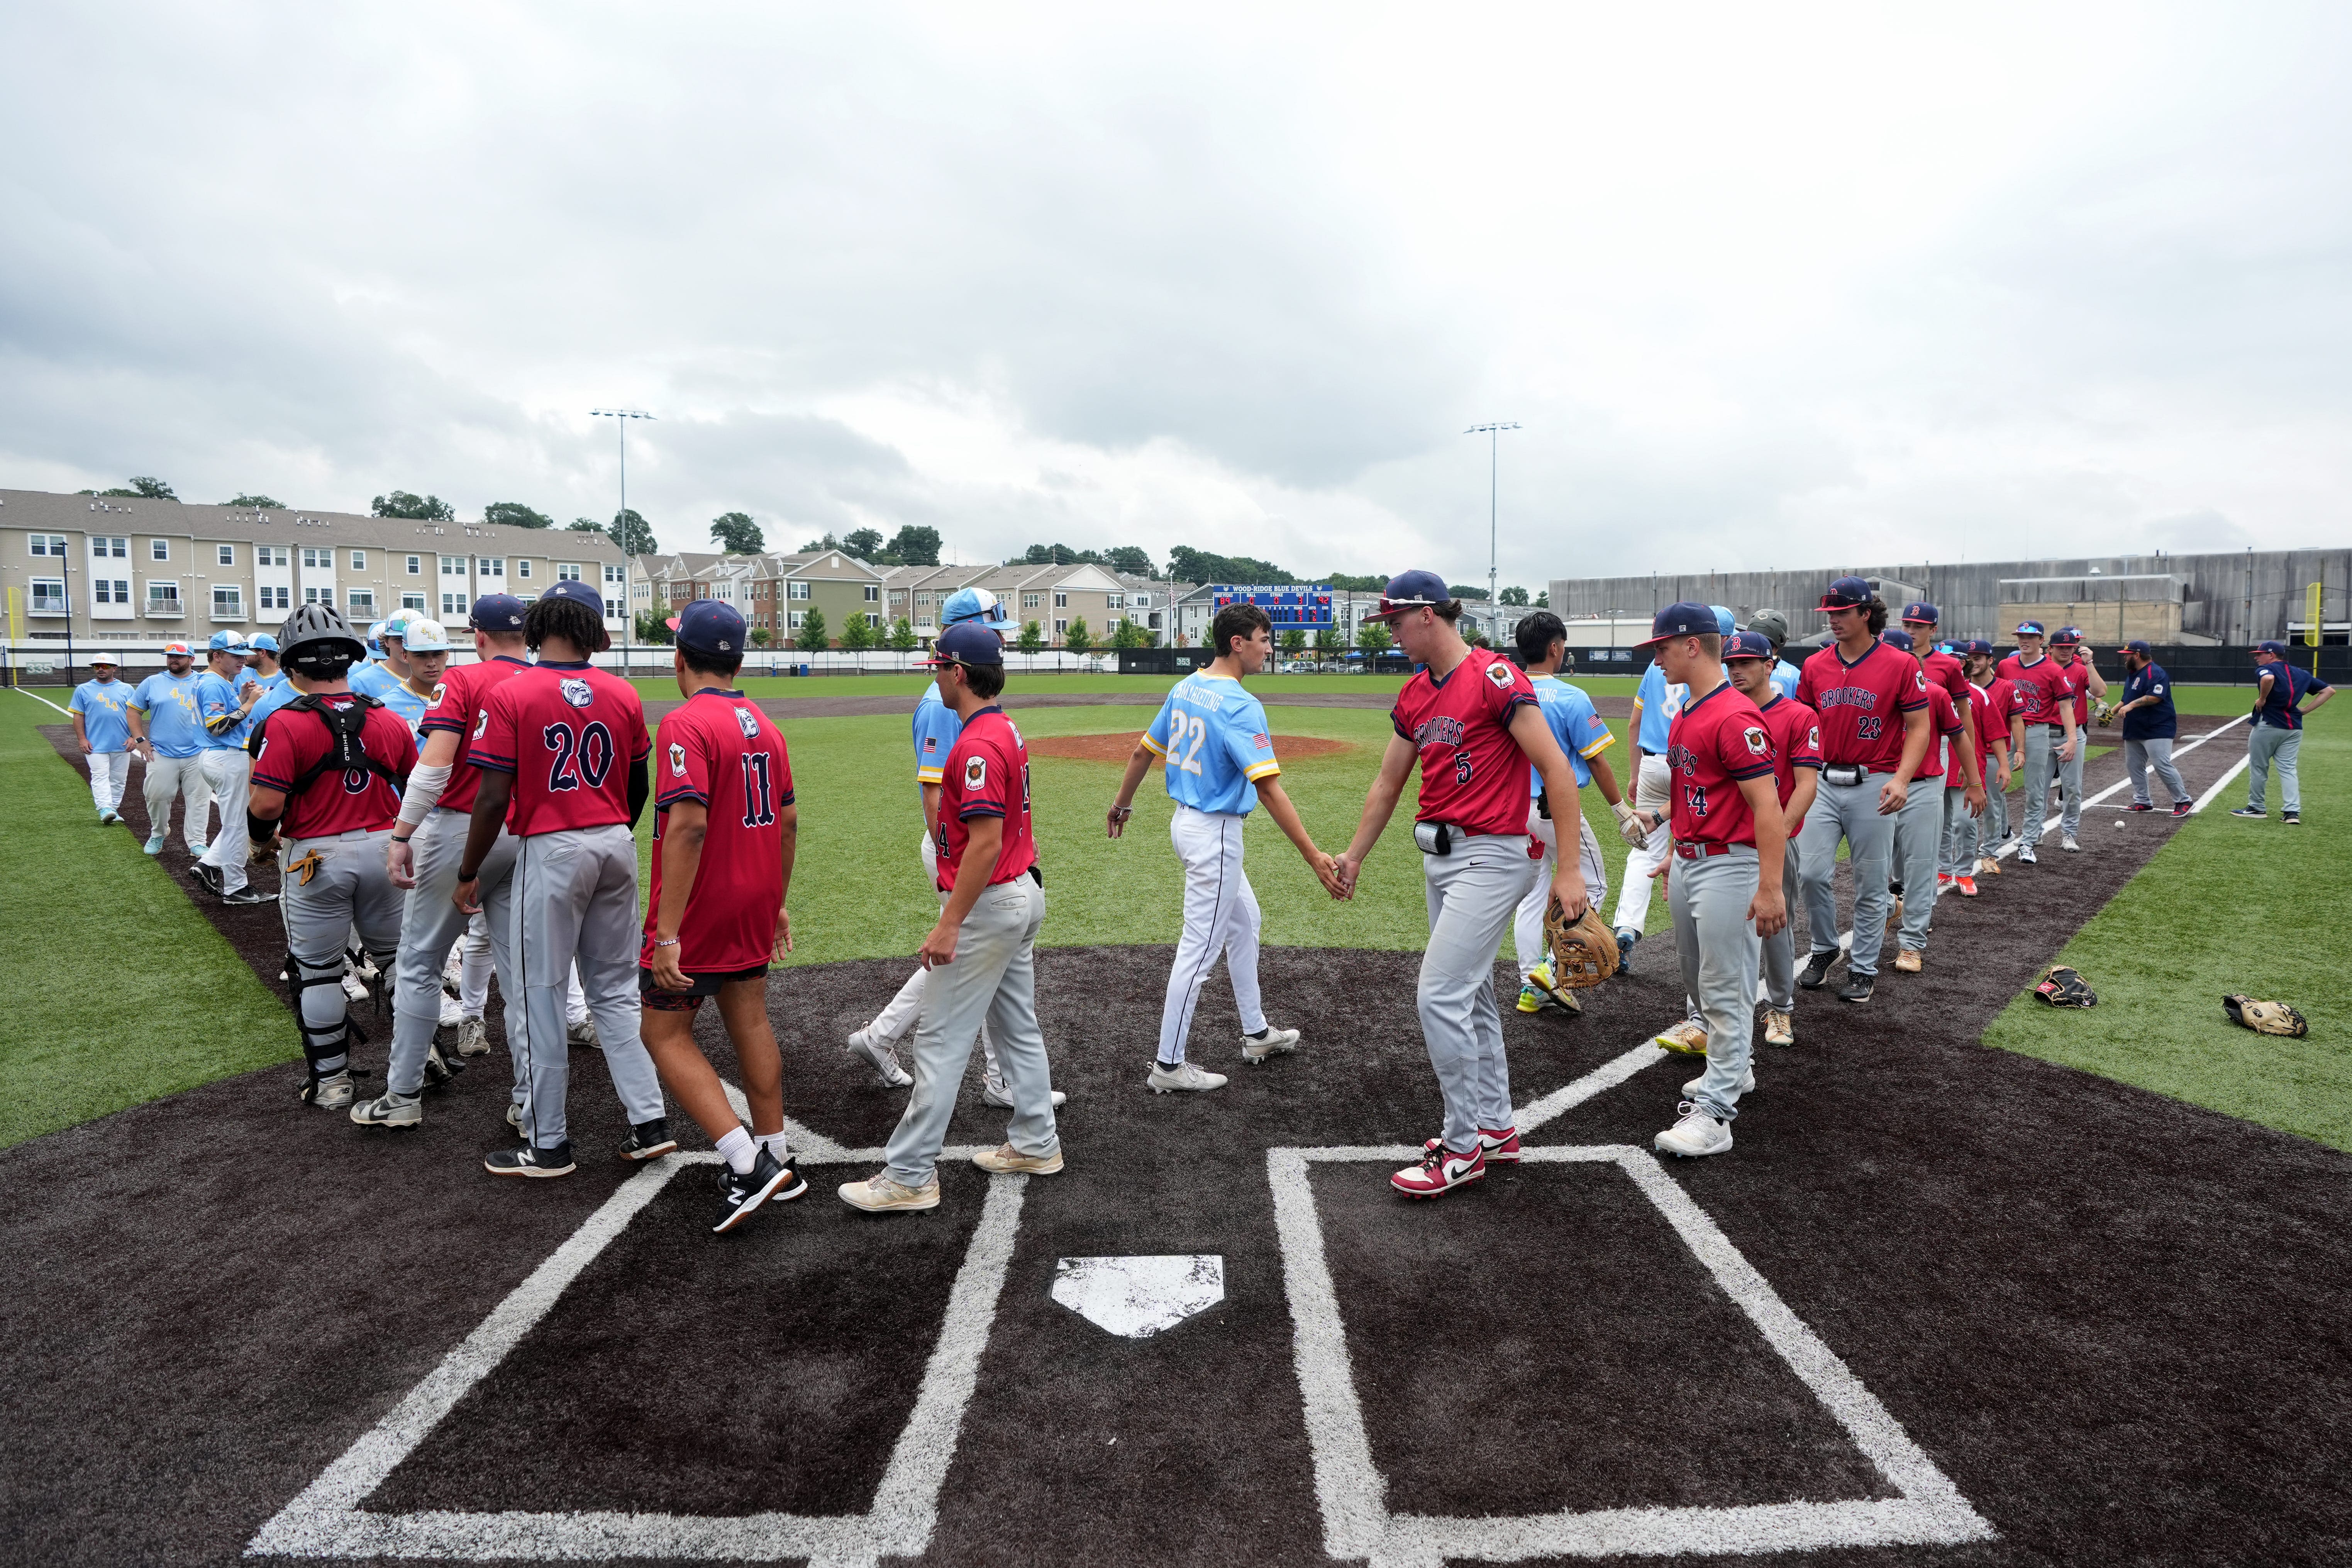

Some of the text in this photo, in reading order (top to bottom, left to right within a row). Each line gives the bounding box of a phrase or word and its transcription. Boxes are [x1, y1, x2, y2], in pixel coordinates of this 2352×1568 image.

[1910, 606, 1920, 616] B
[421, 627, 437, 641] 414
[1731, 637, 1741, 651] B
[1969, 642, 1976, 650] B
[27, 663, 53, 673] 335
[96, 693, 119, 711] 414
[169, 688, 191, 710] 414
[1820, 687, 1877, 711] BROOKERS
[2026, 698, 2041, 713] 21
[1413, 716, 1465, 752] BROOKERS
[1857, 716, 1881, 740] 23
[341, 718, 350, 761] ESHIELD
[1166, 709, 1206, 776] 22
[543, 721, 615, 792] 20
[1454, 751, 1473, 785] 5
[742, 751, 774, 829] 11
[1598, 946, 1608, 966] A2000
